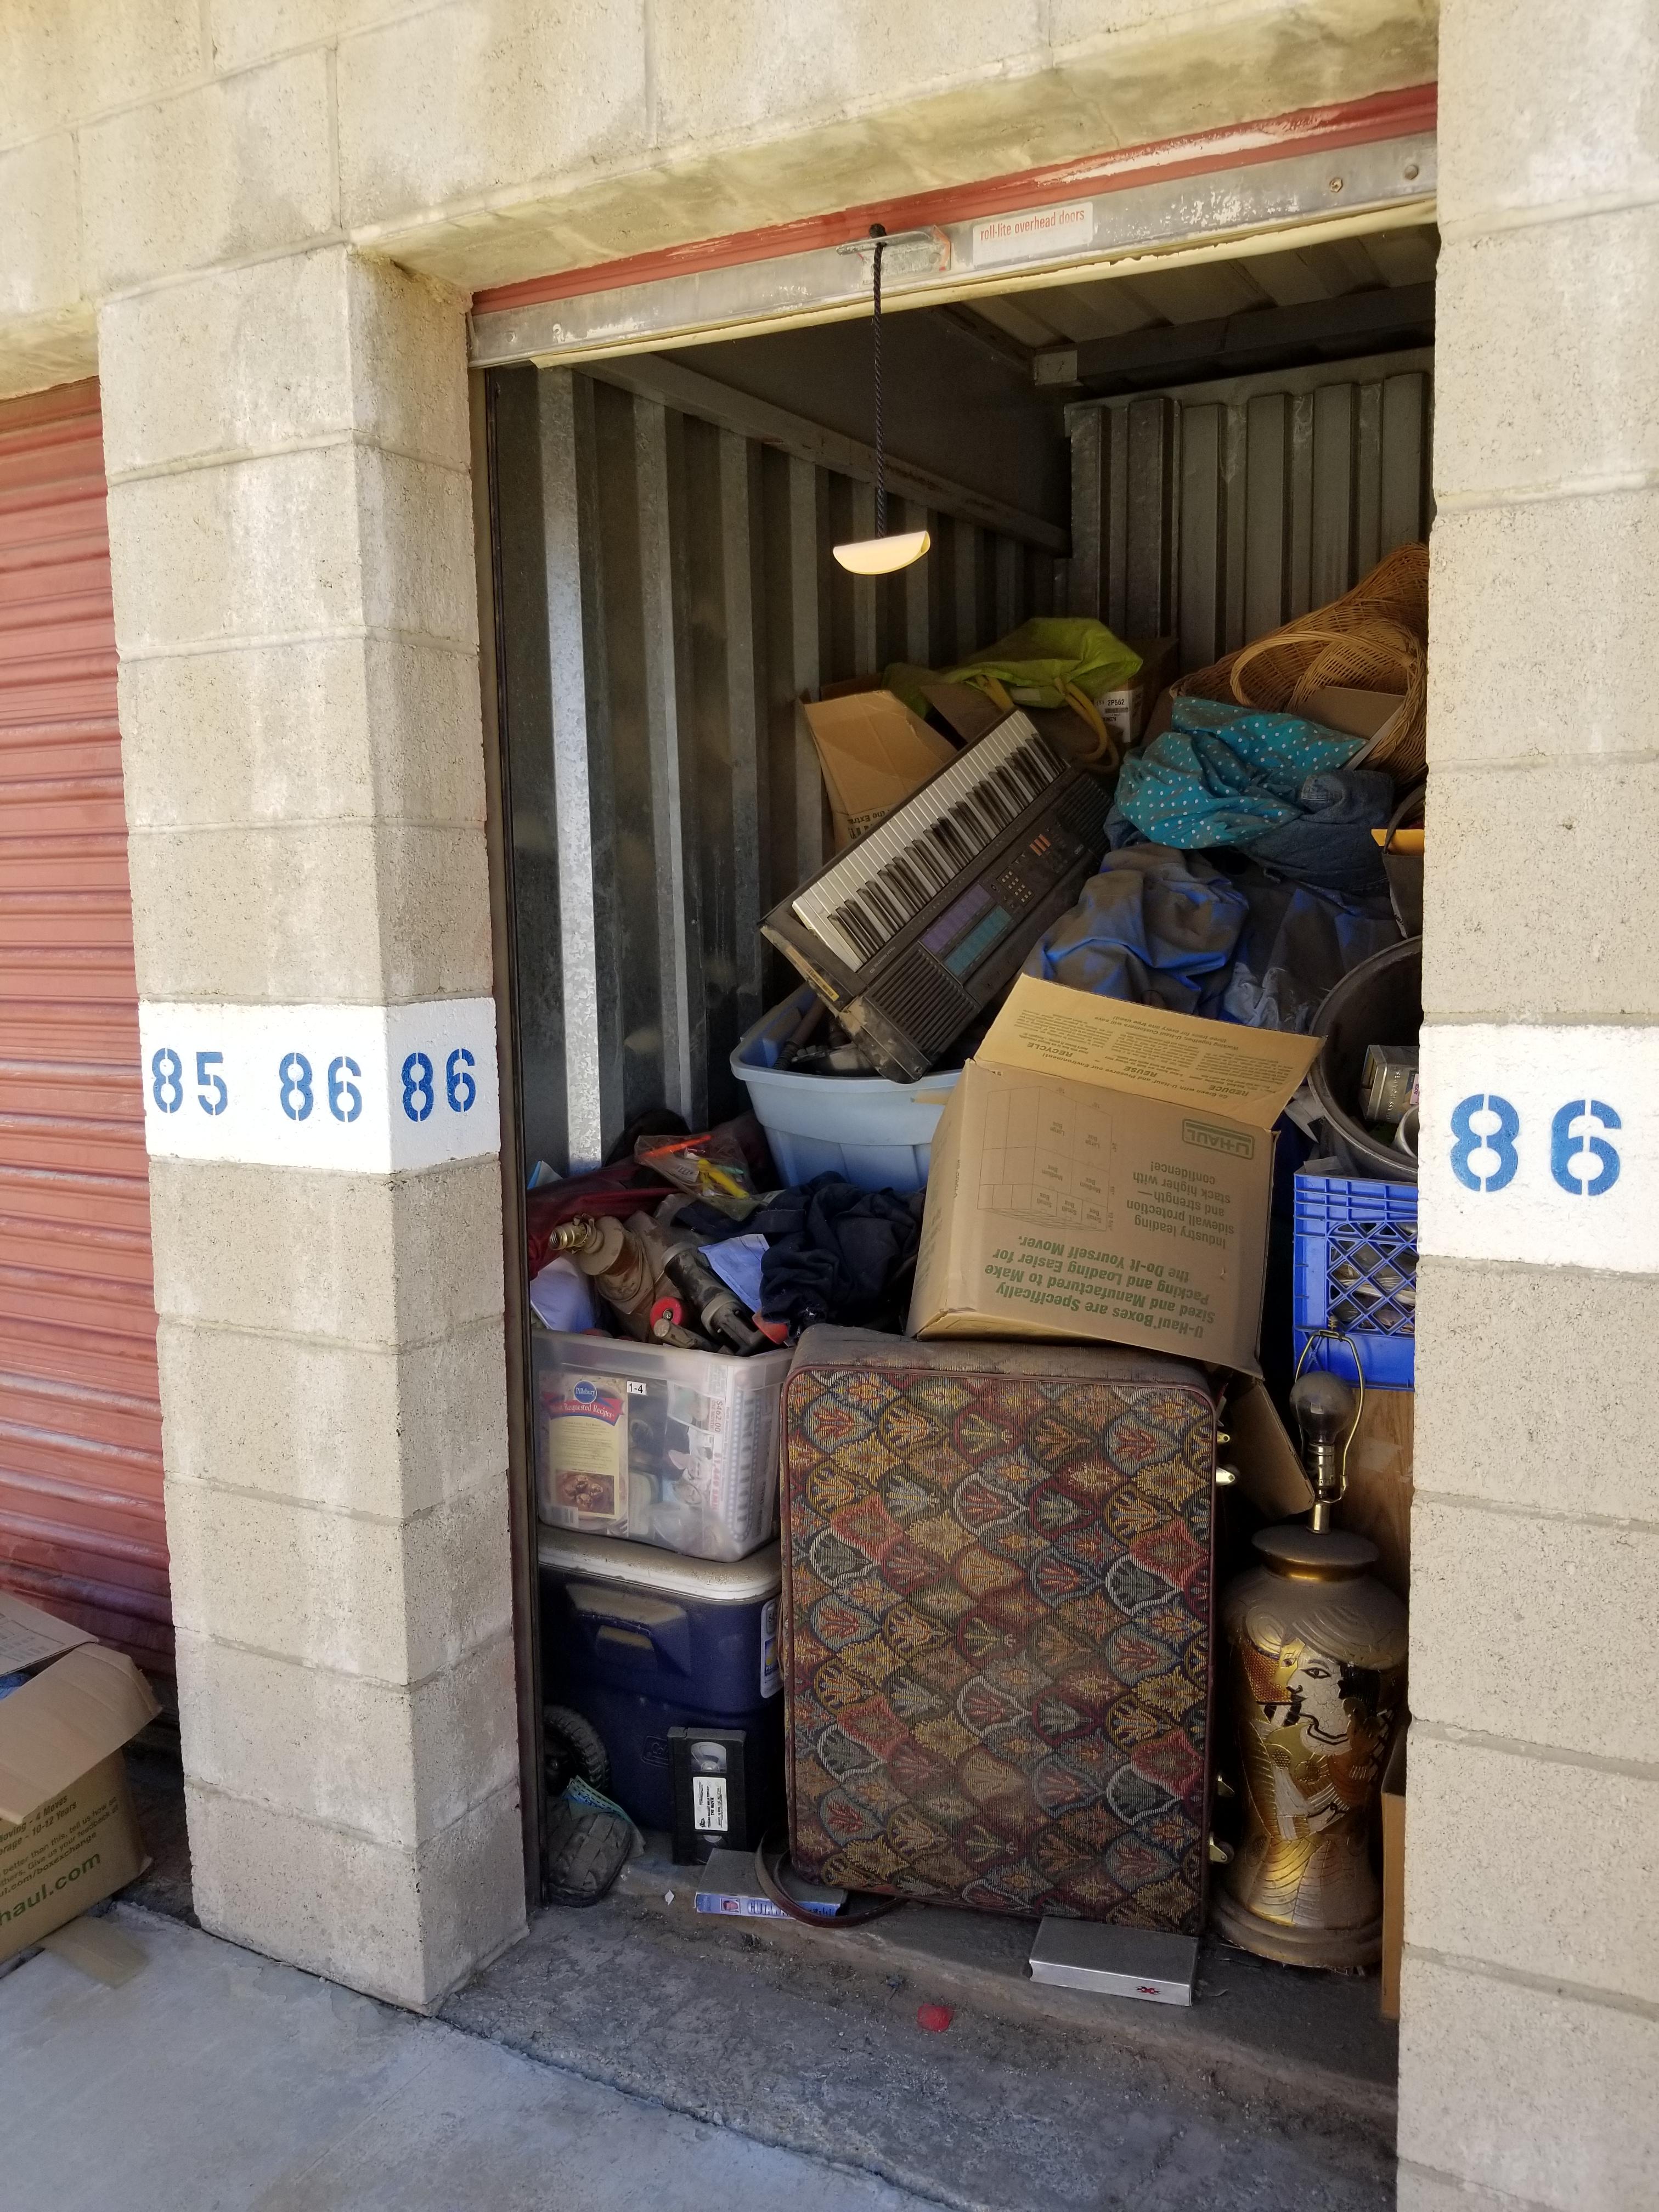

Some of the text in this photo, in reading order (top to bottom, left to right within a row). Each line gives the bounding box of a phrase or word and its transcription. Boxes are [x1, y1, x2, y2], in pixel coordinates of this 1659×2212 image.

[980, 210, 1084, 240] roll-lite overhead doors
[1026, 1042, 1073, 1057] RECYCLE
[1123, 1066, 1158, 1077] REUSE
[151, 1048, 363, 1123] 85 86
[402, 1048, 476, 1122] 86
[1209, 1085, 1249, 1097] REDUCE
[1184, 1129, 1251, 1155] U-HAUL
[1451, 1094, 1622, 1196] 86
[1150, 1161, 1215, 1185] confidence!
[1133, 1172, 1231, 1204] stack higher with
[1126, 1200, 1185, 1221] protection
[1204, 1204, 1224, 1217] and
[1135, 1214, 1176, 1237] leading
[1180, 1225, 1227, 1249] Industry
[1189, 1215, 1234, 1235] sidewall
[1018, 1235, 1189, 1283] the Do-It Yourself Mover.
[992, 1249, 1210, 1305] Packing and Loading Easier for
[985, 1265, 1215, 1323] Sized and Manufactured to Make
[995, 1282, 1081, 1311] Specifically
[1085, 1302, 1108, 1314] are
[1111, 1307, 1154, 1327] Boxes
[629, 1383, 643, 1393] 1-4
[565, 1403, 591, 1412] Requested
[43, 1796, 68, 1815] Moves
[32, 1817, 54, 1836] 10-12
[57, 1802, 77, 1820] Years
[3, 1857, 28, 1875] better
[31, 1844, 48, 1857] than
[69, 1820, 81, 1833] tell
[83, 1816, 91, 1825] us
[93, 1804, 107, 1818] how
[28, 1857, 46, 1870] Give
[48, 1849, 57, 1858] us
[59, 1836, 76, 1853] your
[77, 1815, 110, 1836] feedback
